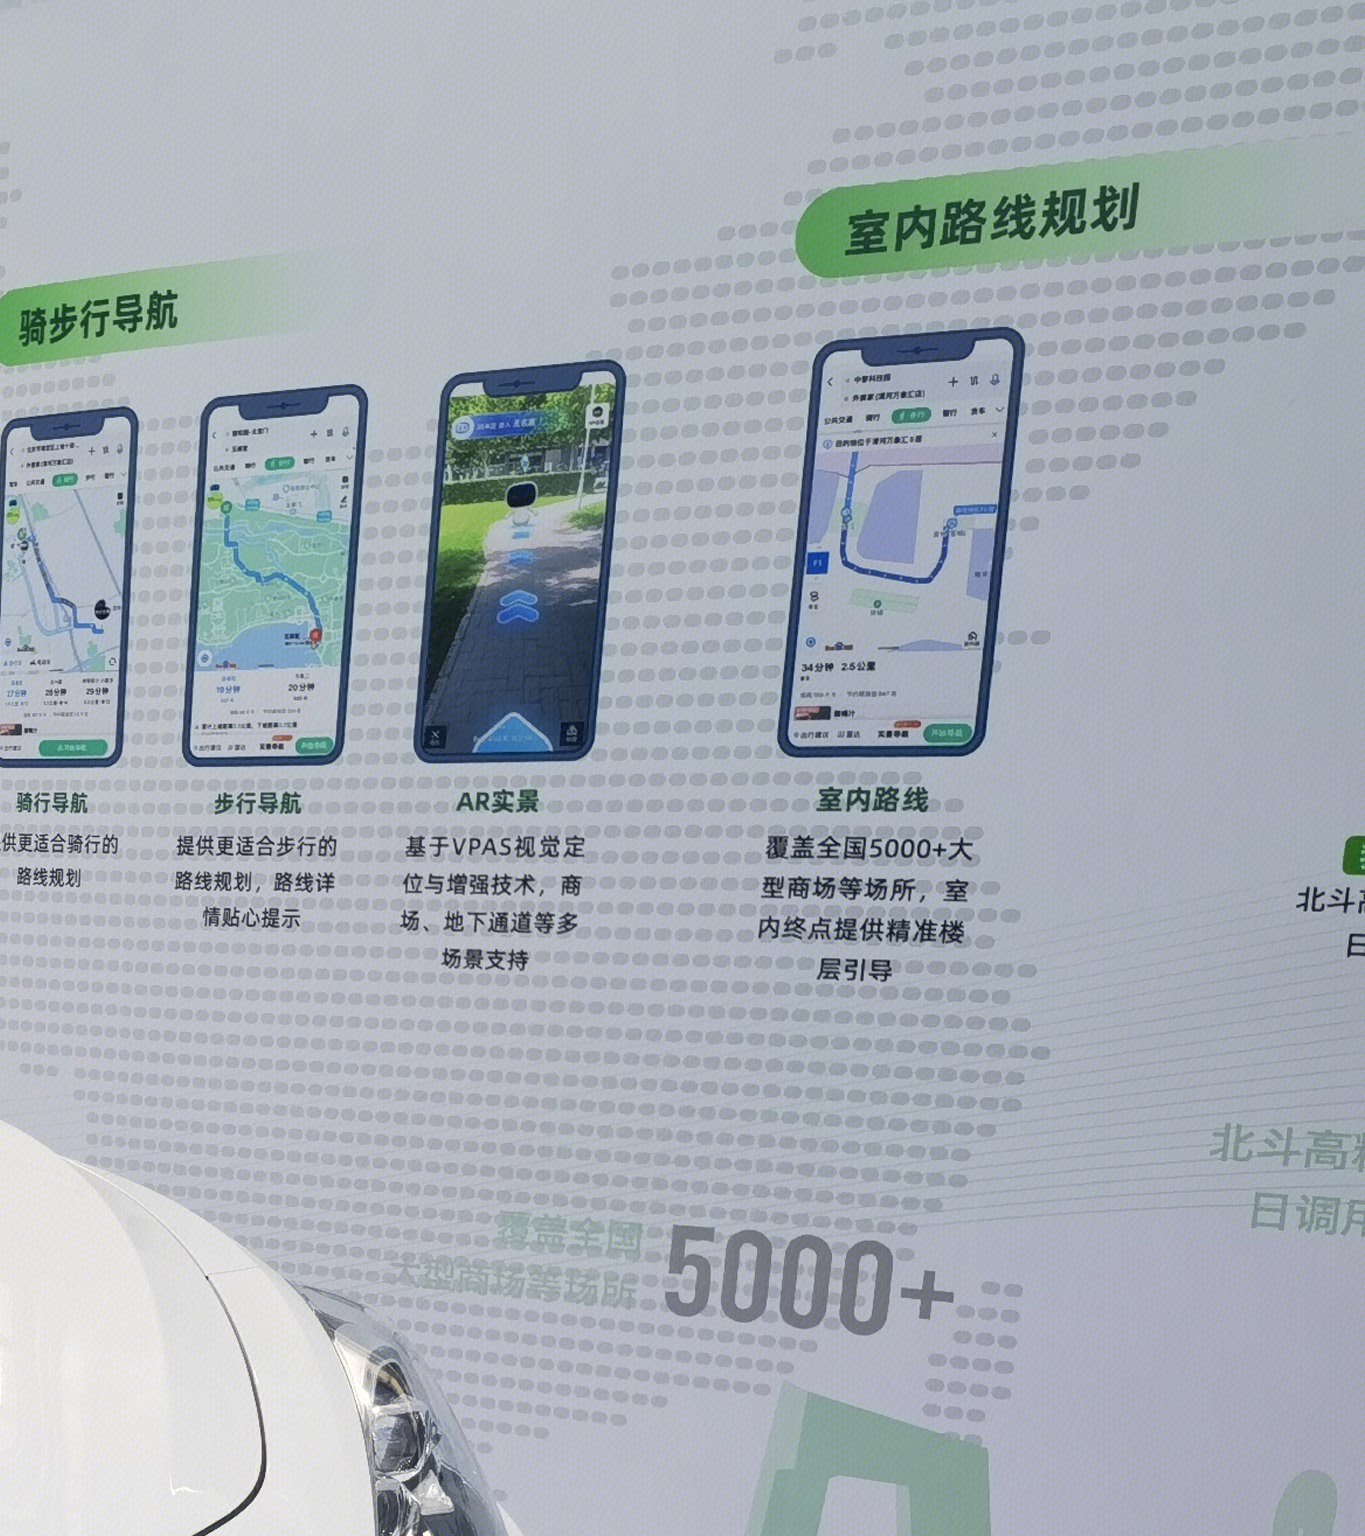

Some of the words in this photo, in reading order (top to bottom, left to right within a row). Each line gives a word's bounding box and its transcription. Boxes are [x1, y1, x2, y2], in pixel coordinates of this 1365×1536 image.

[844, 182, 1140, 257] 室内路线规划
[18, 289, 179, 348] 骑步行导航
[16, 791, 88, 815] 骑行导航
[214, 791, 302, 816] 步行导航
[455, 788, 540, 814] AR实景
[815, 786, 930, 813] 室内路线
[176, 834, 338, 858] 提供更适合步行的
[404, 834, 586, 860] 基于VPAS视觉定
[765, 834, 974, 862] 覆盖全国5000+大
[16, 866, 82, 888] 路线规划
[174, 870, 337, 894] 路线规划，路线详
[402, 872, 584, 898] 位与增强技术，商
[760, 875, 969, 904] 型商场等场所，室
[1295, 886, 1365, 914] 北斗
[202, 906, 302, 930] 情贴心提示
[399, 909, 579, 936] 场、地下通道等多
[757, 915, 965, 944] 内终点提供精准楼
[441, 947, 530, 972] 场景支持
[816, 957, 893, 983] 层引导
[493, 1210, 643, 1260] 覆盖全国
[389, 1260, 639, 1310] 大型商场等场所
[664, 1223, 955, 1338] 5000+
